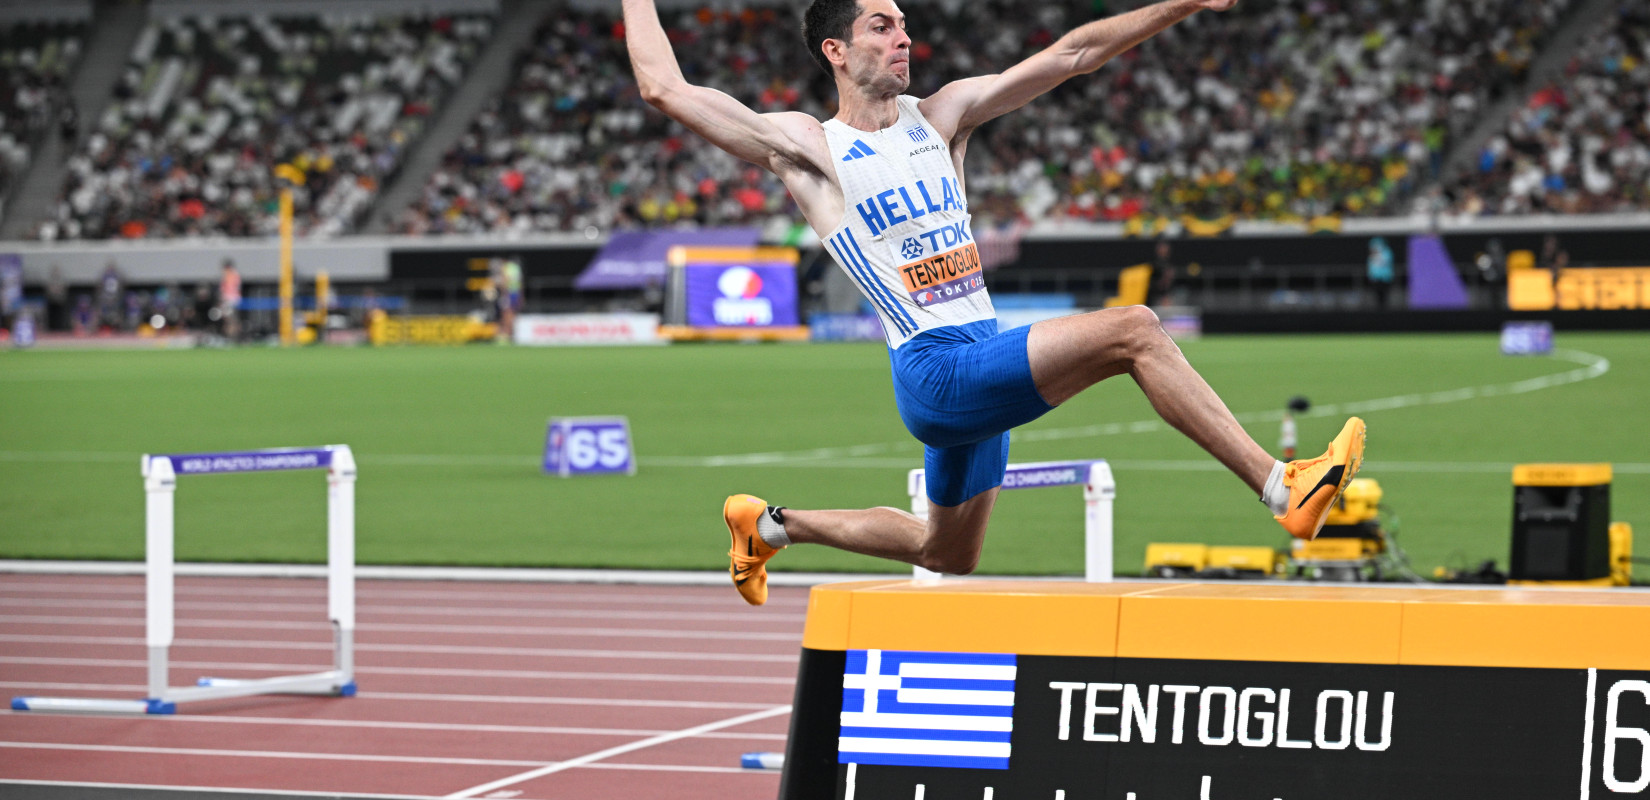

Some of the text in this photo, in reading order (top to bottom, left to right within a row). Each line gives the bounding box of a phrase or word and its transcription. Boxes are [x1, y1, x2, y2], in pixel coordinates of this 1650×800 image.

[855, 176, 964, 237] HELLAS
[919, 219, 971, 252] TDK
[902, 245, 979, 288] TENTOGLOU
[567, 428, 628, 469] 65
[1049, 681, 1394, 751] TENTOGLOU
[1603, 679, 1650, 793] 6
